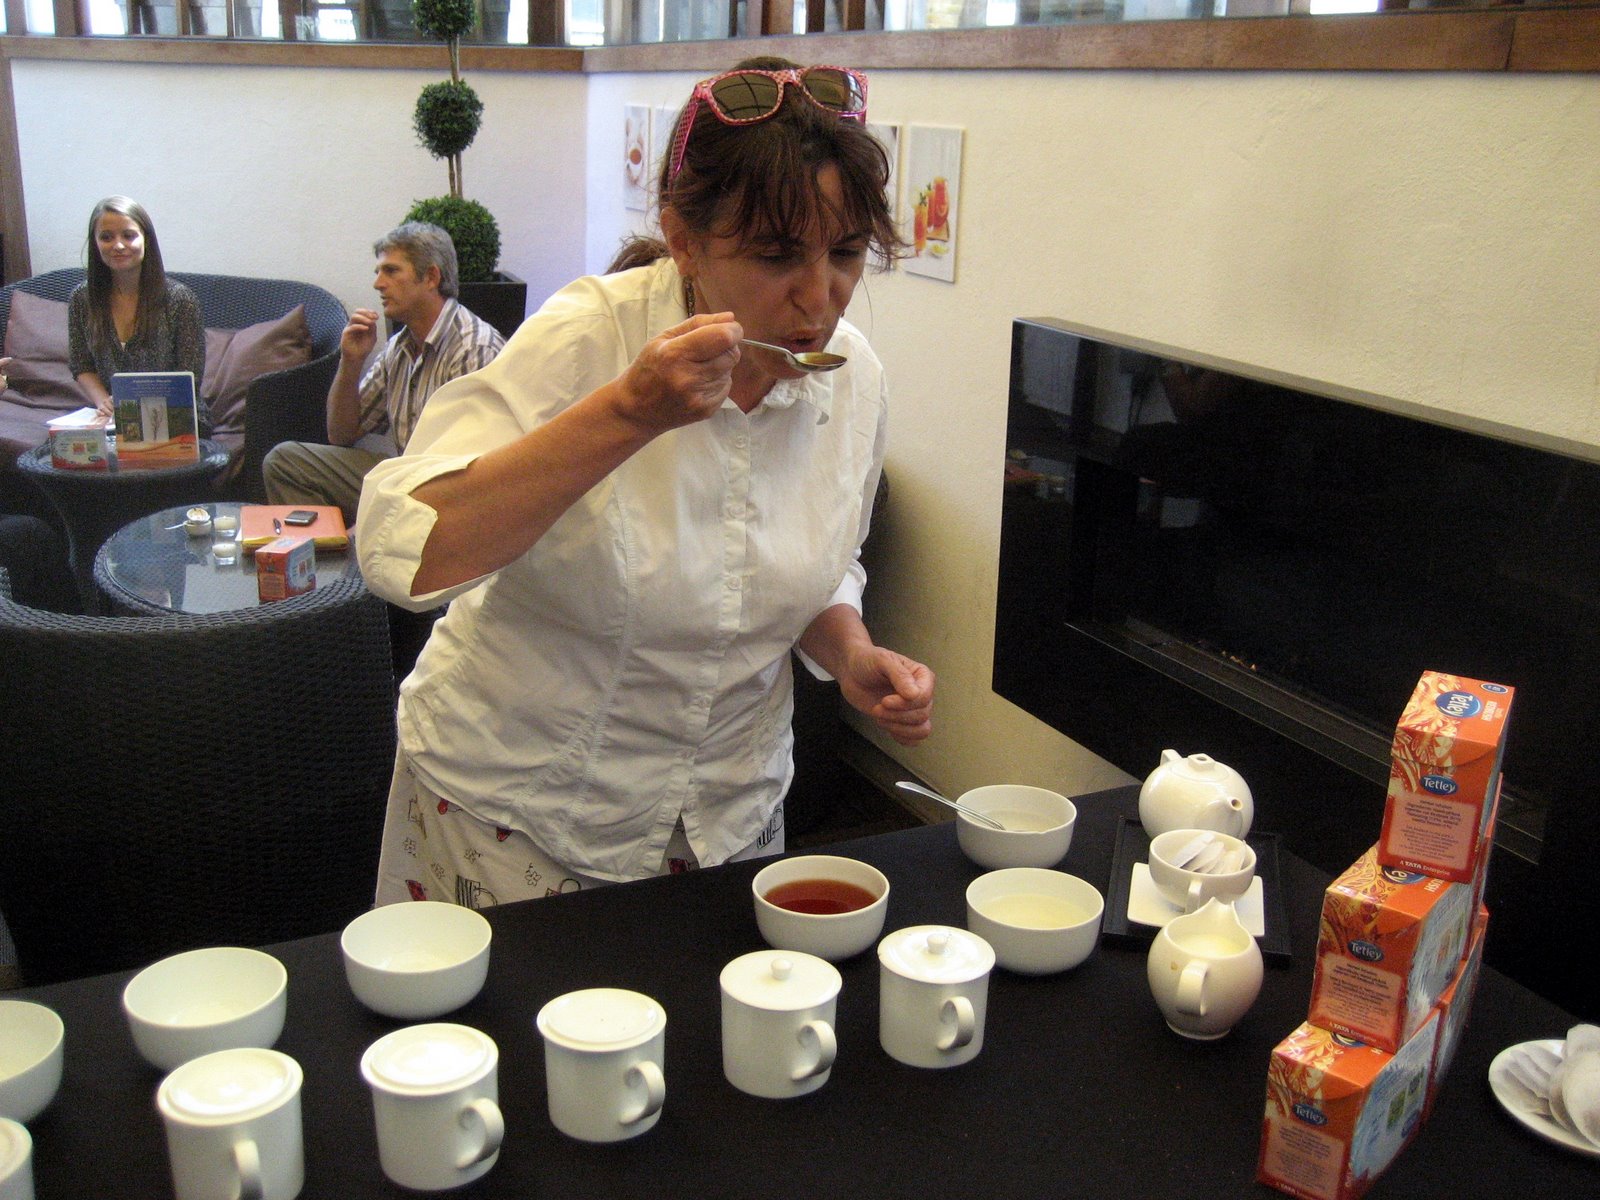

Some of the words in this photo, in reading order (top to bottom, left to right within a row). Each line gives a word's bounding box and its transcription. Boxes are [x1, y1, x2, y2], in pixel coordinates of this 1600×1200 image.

[1446, 693, 1474, 717] Tetley
[1423, 776, 1456, 794] Tetley
[1405, 861, 1422, 870] TATA
[1351, 941, 1382, 961] Tetley
[1295, 1104, 1327, 1125] Tetley
